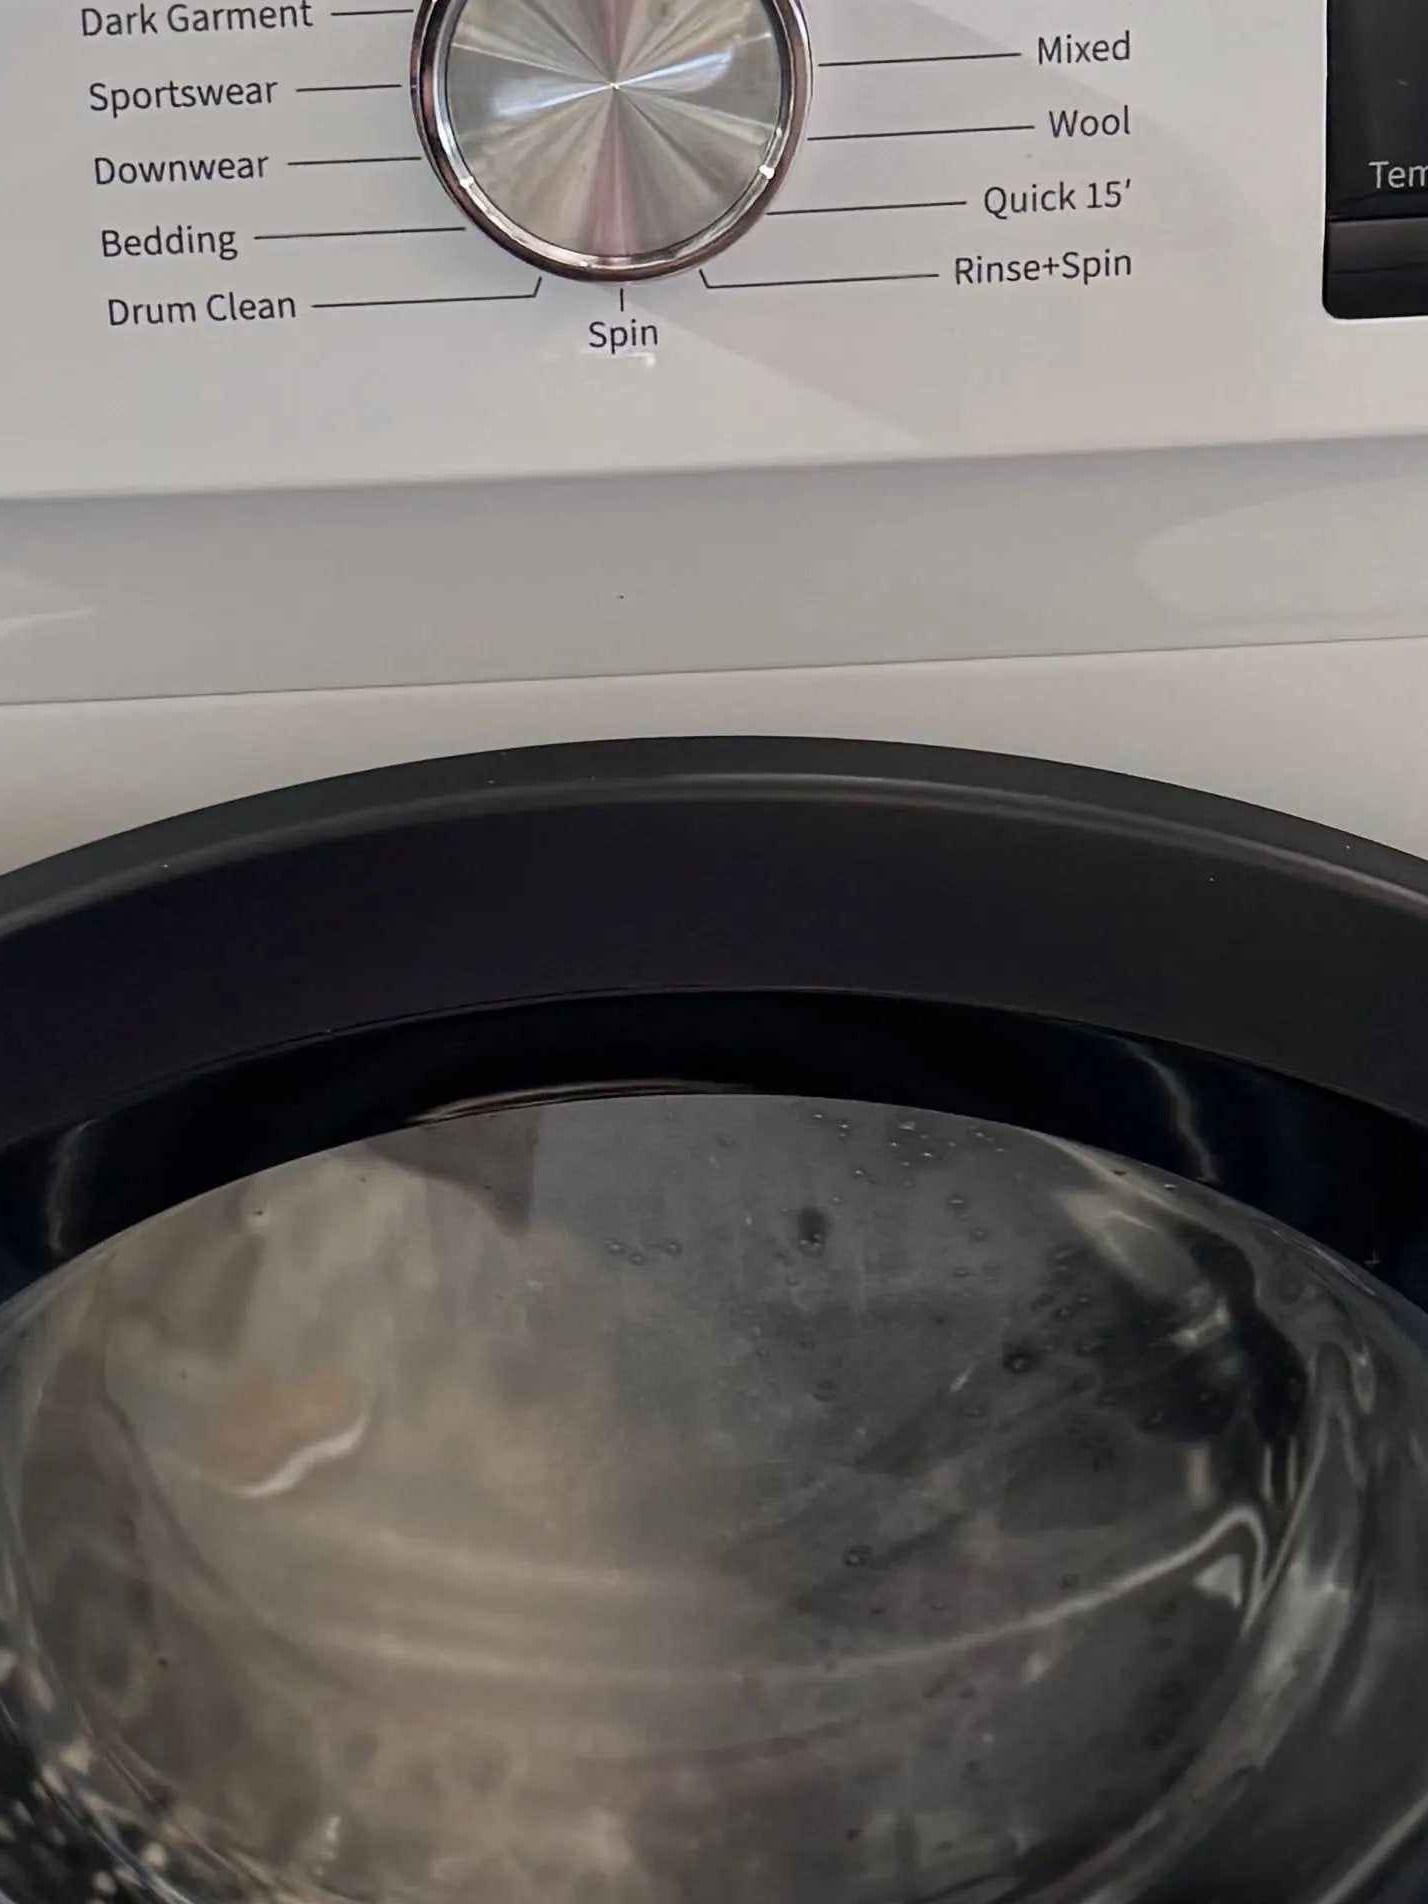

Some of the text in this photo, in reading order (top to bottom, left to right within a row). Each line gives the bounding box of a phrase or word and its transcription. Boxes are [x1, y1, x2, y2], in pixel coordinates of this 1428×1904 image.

[81, 0, 313, 36] Dark Garment
[1039, 30, 1130, 65] Mixed
[90, 81, 278, 118] Sportswear
[1049, 105, 1130, 138] Wool
[95, 156, 269, 185] Downwear
[984, 178, 1130, 220] Quick 15'
[102, 225, 238, 260] Bedding
[955, 249, 1131, 285] Rinse+Spin
[108, 292, 296, 325] Drum Clean
[589, 319, 657, 354] Spin
